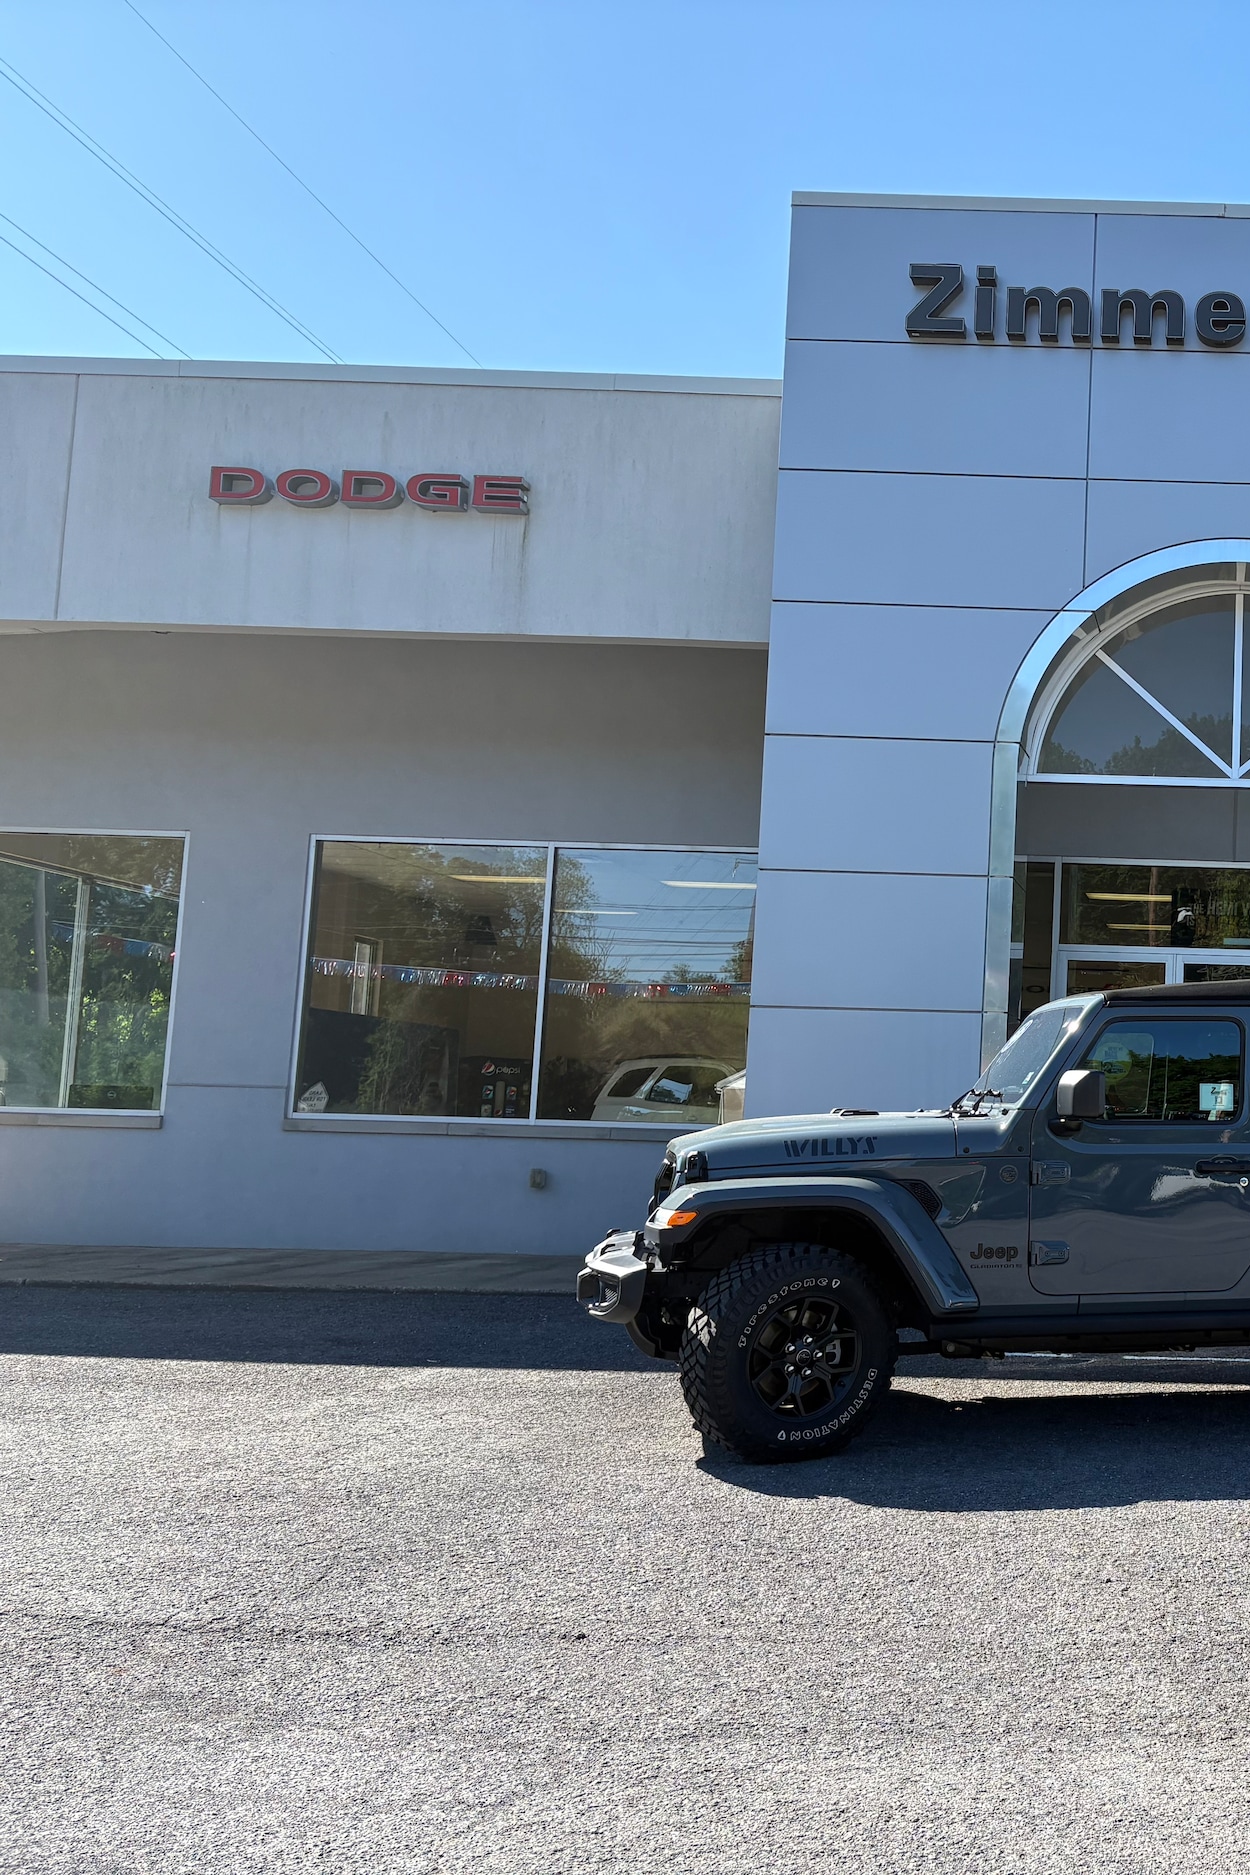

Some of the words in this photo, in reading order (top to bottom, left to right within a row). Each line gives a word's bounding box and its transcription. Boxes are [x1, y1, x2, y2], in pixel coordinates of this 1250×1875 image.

[209, 466, 531, 515] DODGE
[496, 1066, 521, 1075] pepsi
[784, 1136, 877, 1158] WILLYS
[970, 1243, 1018, 1262] Jeep
[790, 1368, 878, 1441] DESTINATION
